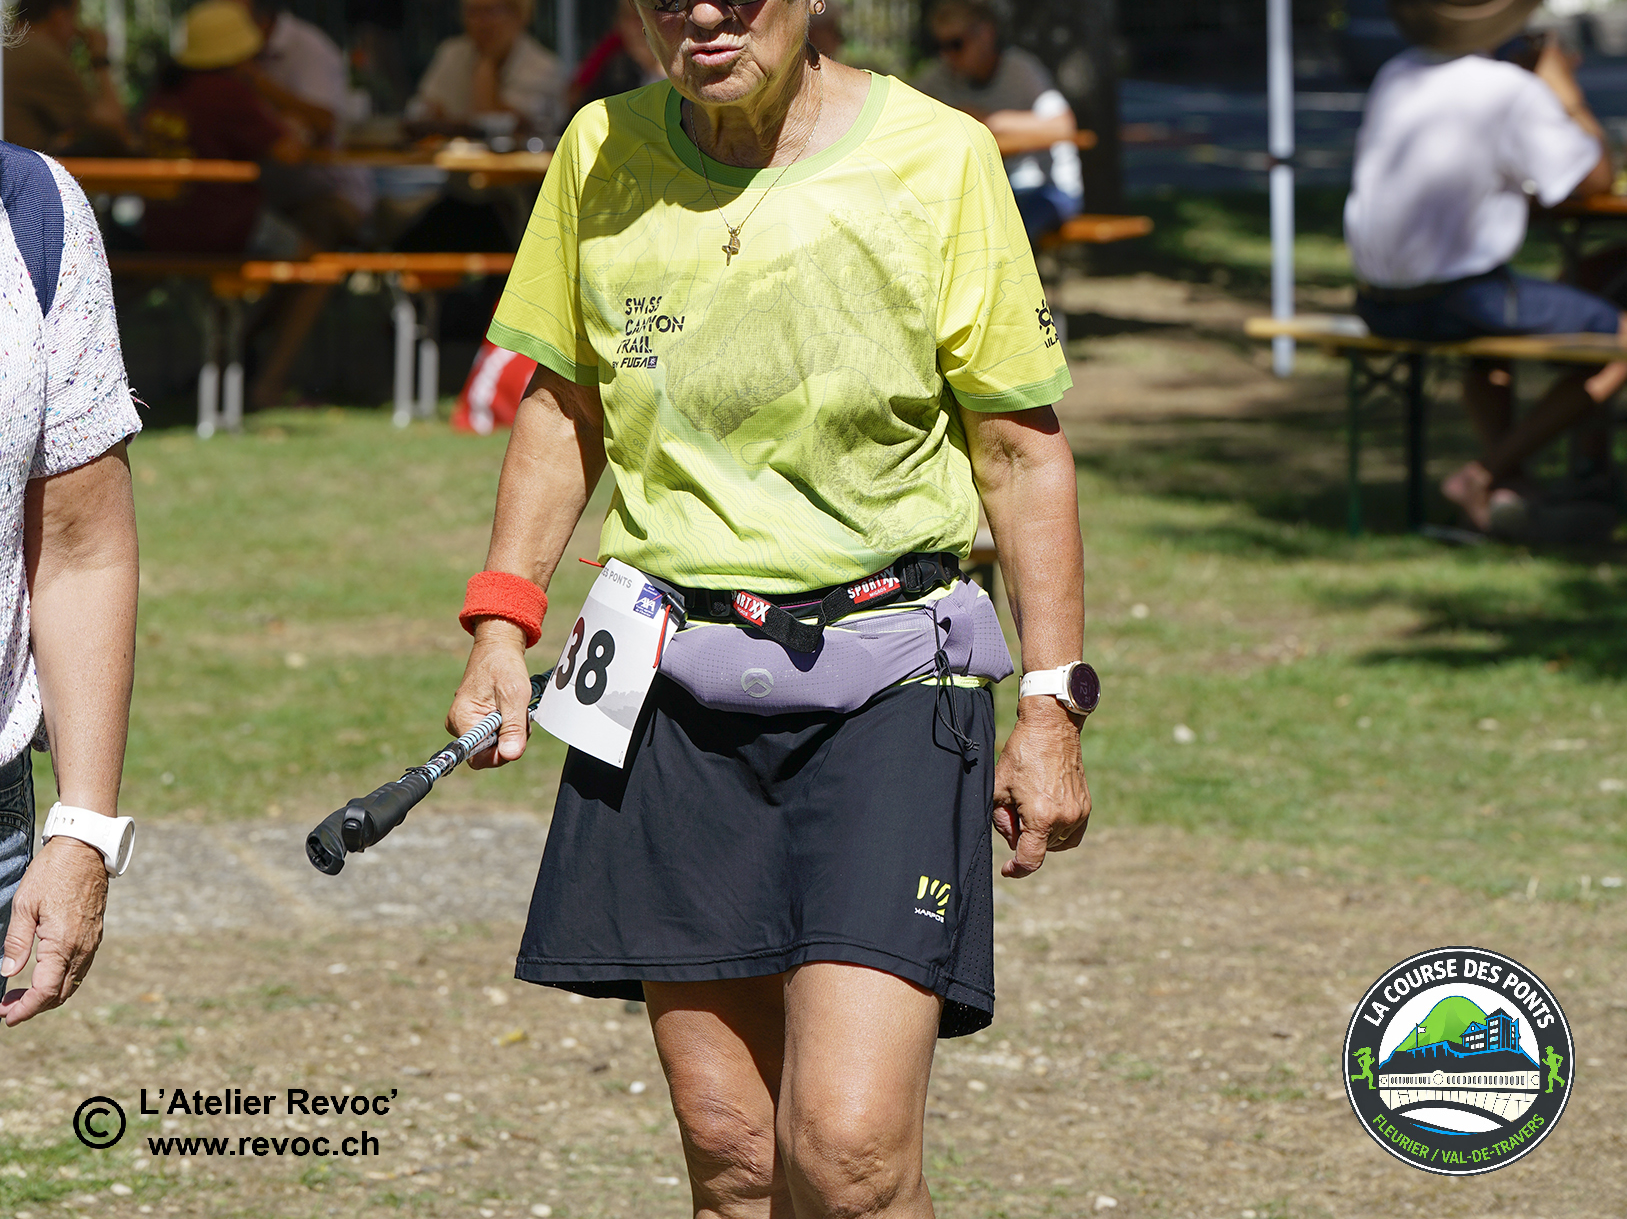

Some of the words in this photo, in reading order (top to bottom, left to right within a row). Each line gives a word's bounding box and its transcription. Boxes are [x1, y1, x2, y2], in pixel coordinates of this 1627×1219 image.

[625, 296, 662, 315] SWISS
[625, 315, 685, 336] CANYON
[616, 336, 652, 354] TRAIL
[610, 571, 633, 589] PONTS
[847, 566, 900, 600] SPORTXX
[635, 597, 656, 612] AXA
